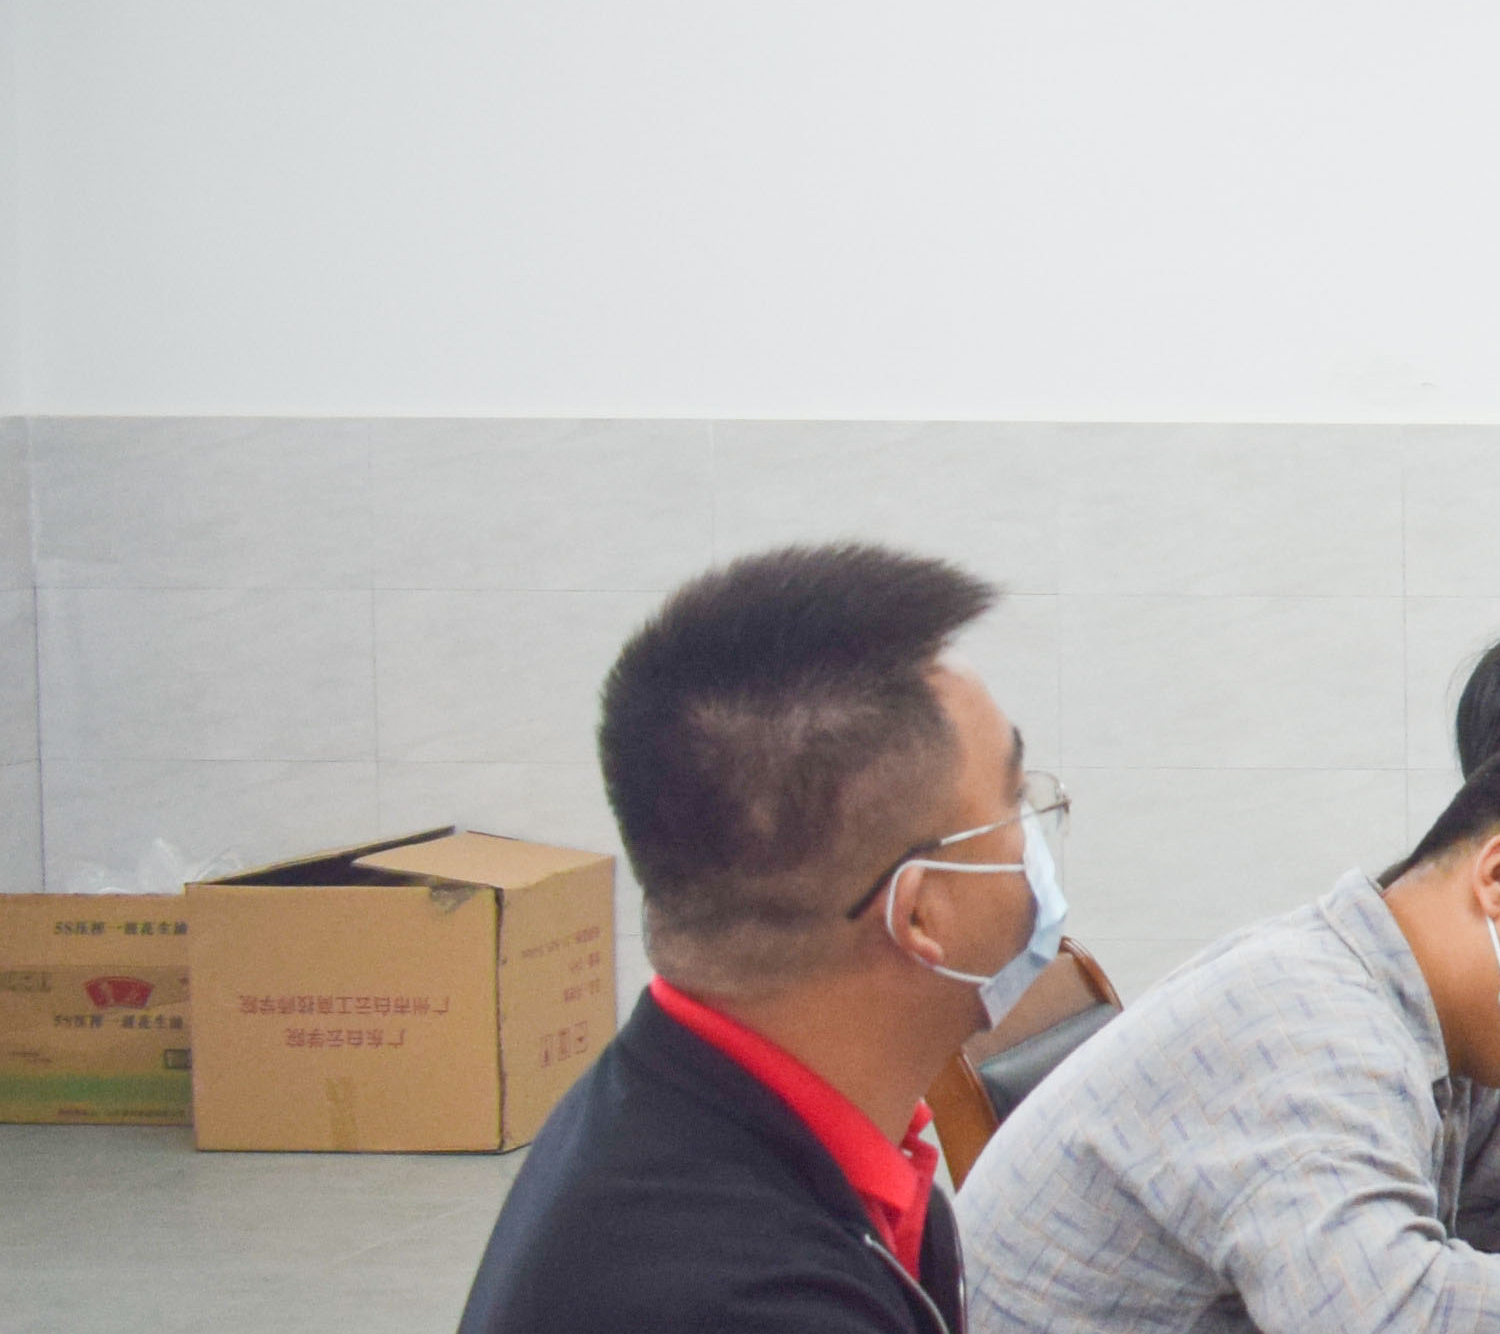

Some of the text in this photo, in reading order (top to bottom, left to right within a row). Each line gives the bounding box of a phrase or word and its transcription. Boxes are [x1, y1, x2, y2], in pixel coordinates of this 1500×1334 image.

[285, 1028, 406, 1048] 广东白云学院
